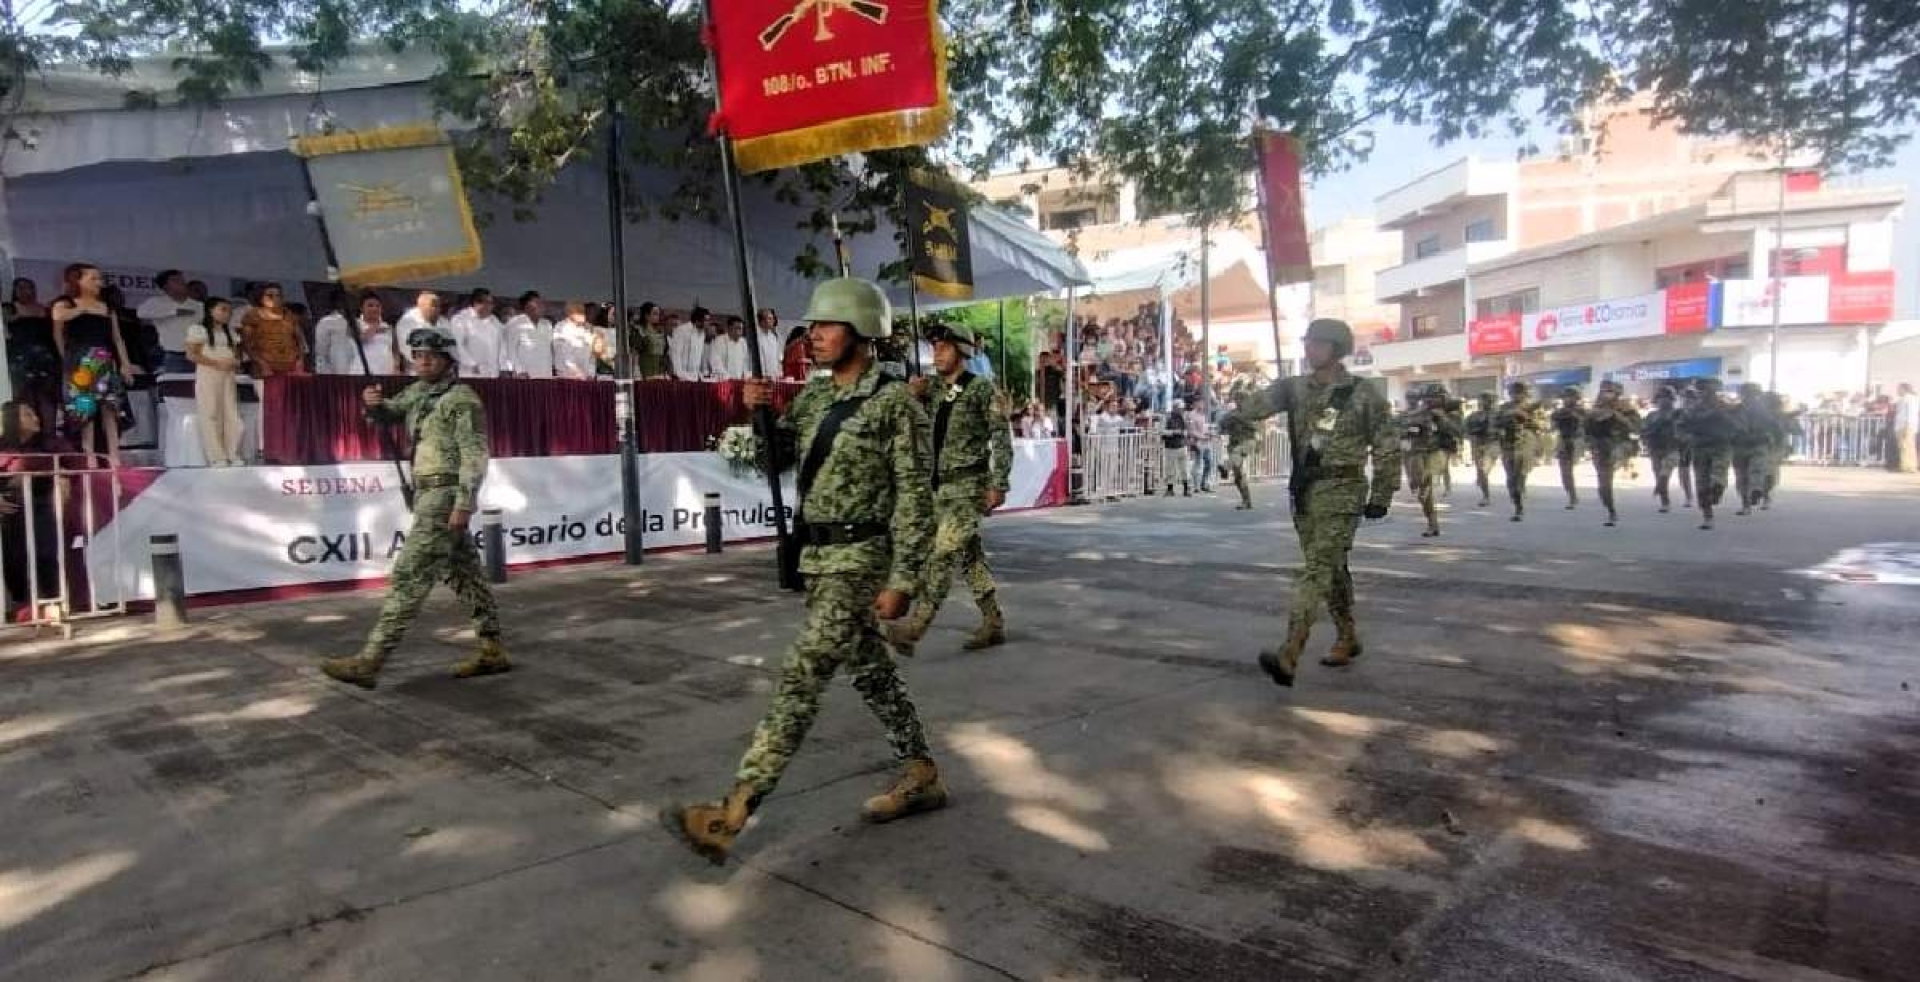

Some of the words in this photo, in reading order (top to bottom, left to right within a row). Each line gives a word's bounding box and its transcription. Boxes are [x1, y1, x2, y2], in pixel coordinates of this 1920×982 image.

[816, 60, 857, 84] BTN.
[861, 53, 896, 76] INF.
[281, 475, 384, 496] SEDENA
[287, 532, 371, 564] CXII
[643, 509, 664, 533] la
